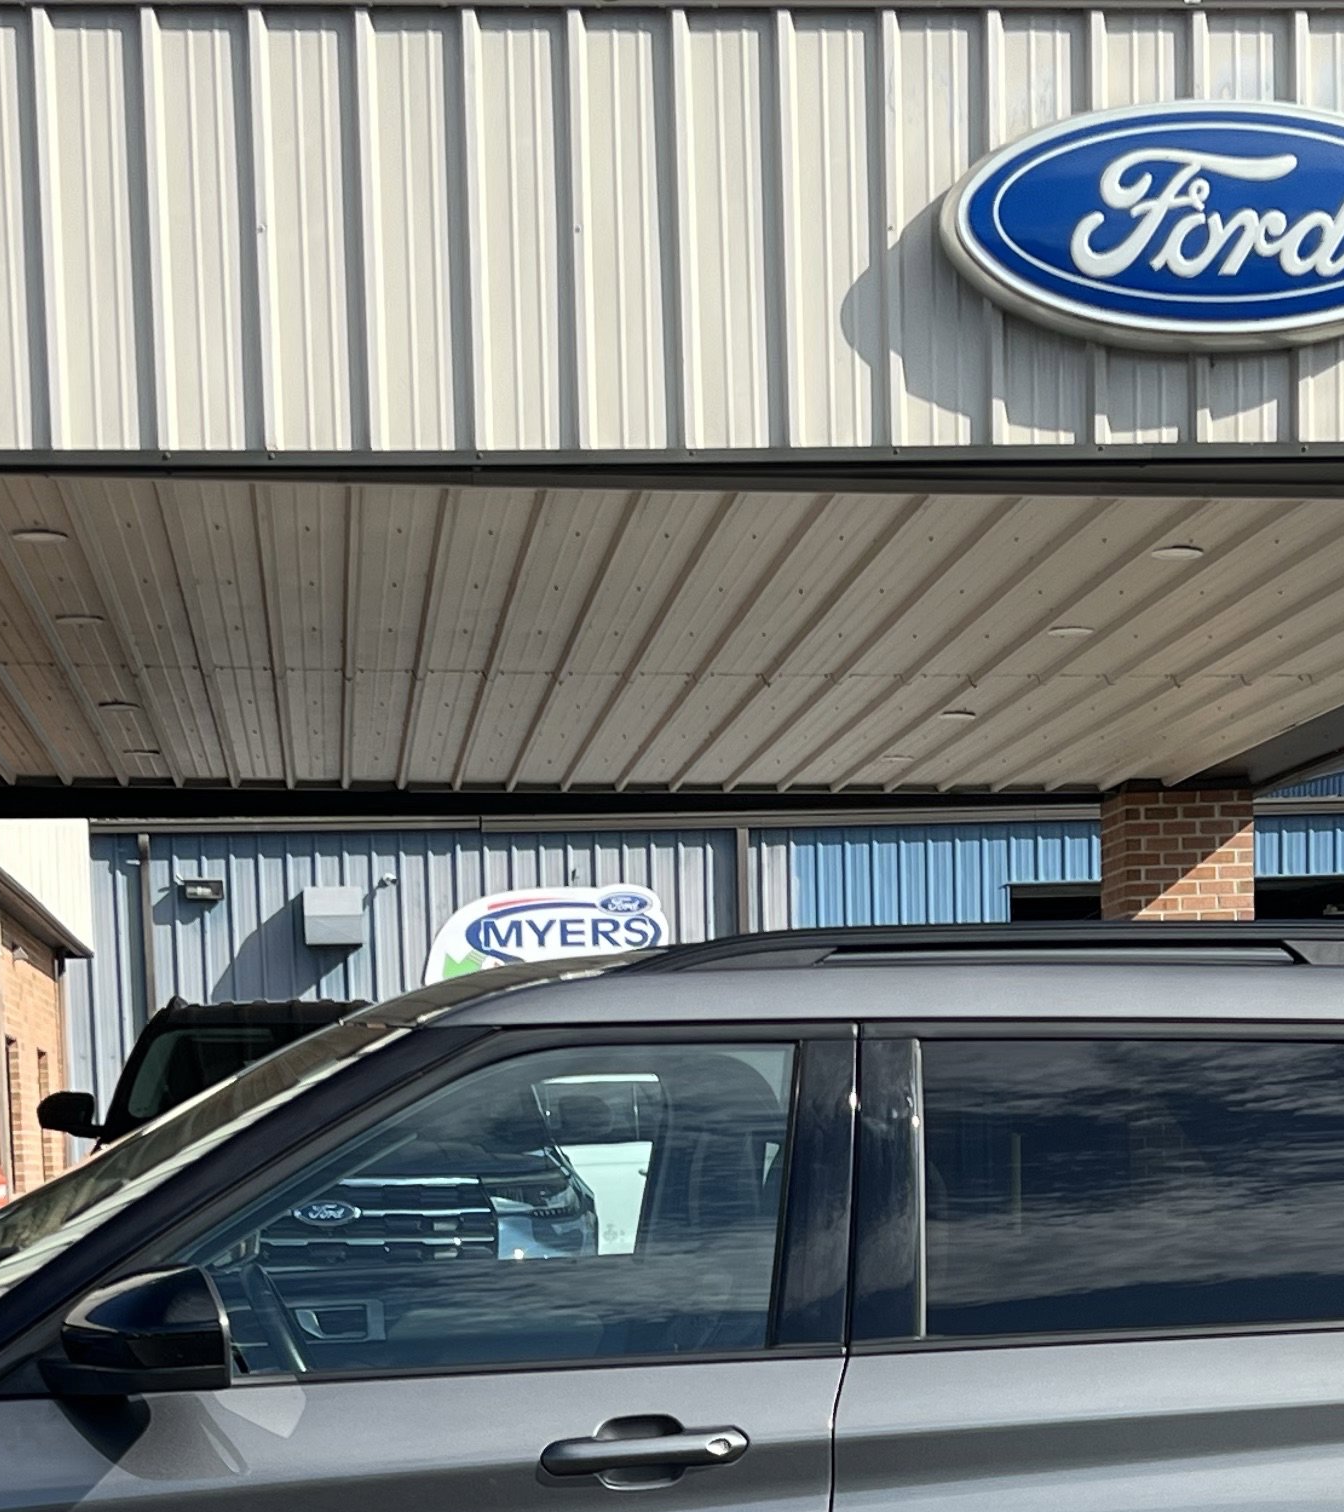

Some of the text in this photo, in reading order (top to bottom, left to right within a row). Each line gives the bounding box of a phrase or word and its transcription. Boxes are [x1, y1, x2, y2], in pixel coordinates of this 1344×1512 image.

[607, 896, 641, 911] Ford
[483, 917, 650, 948] MYERS
[308, 1204, 345, 1219] Ford
